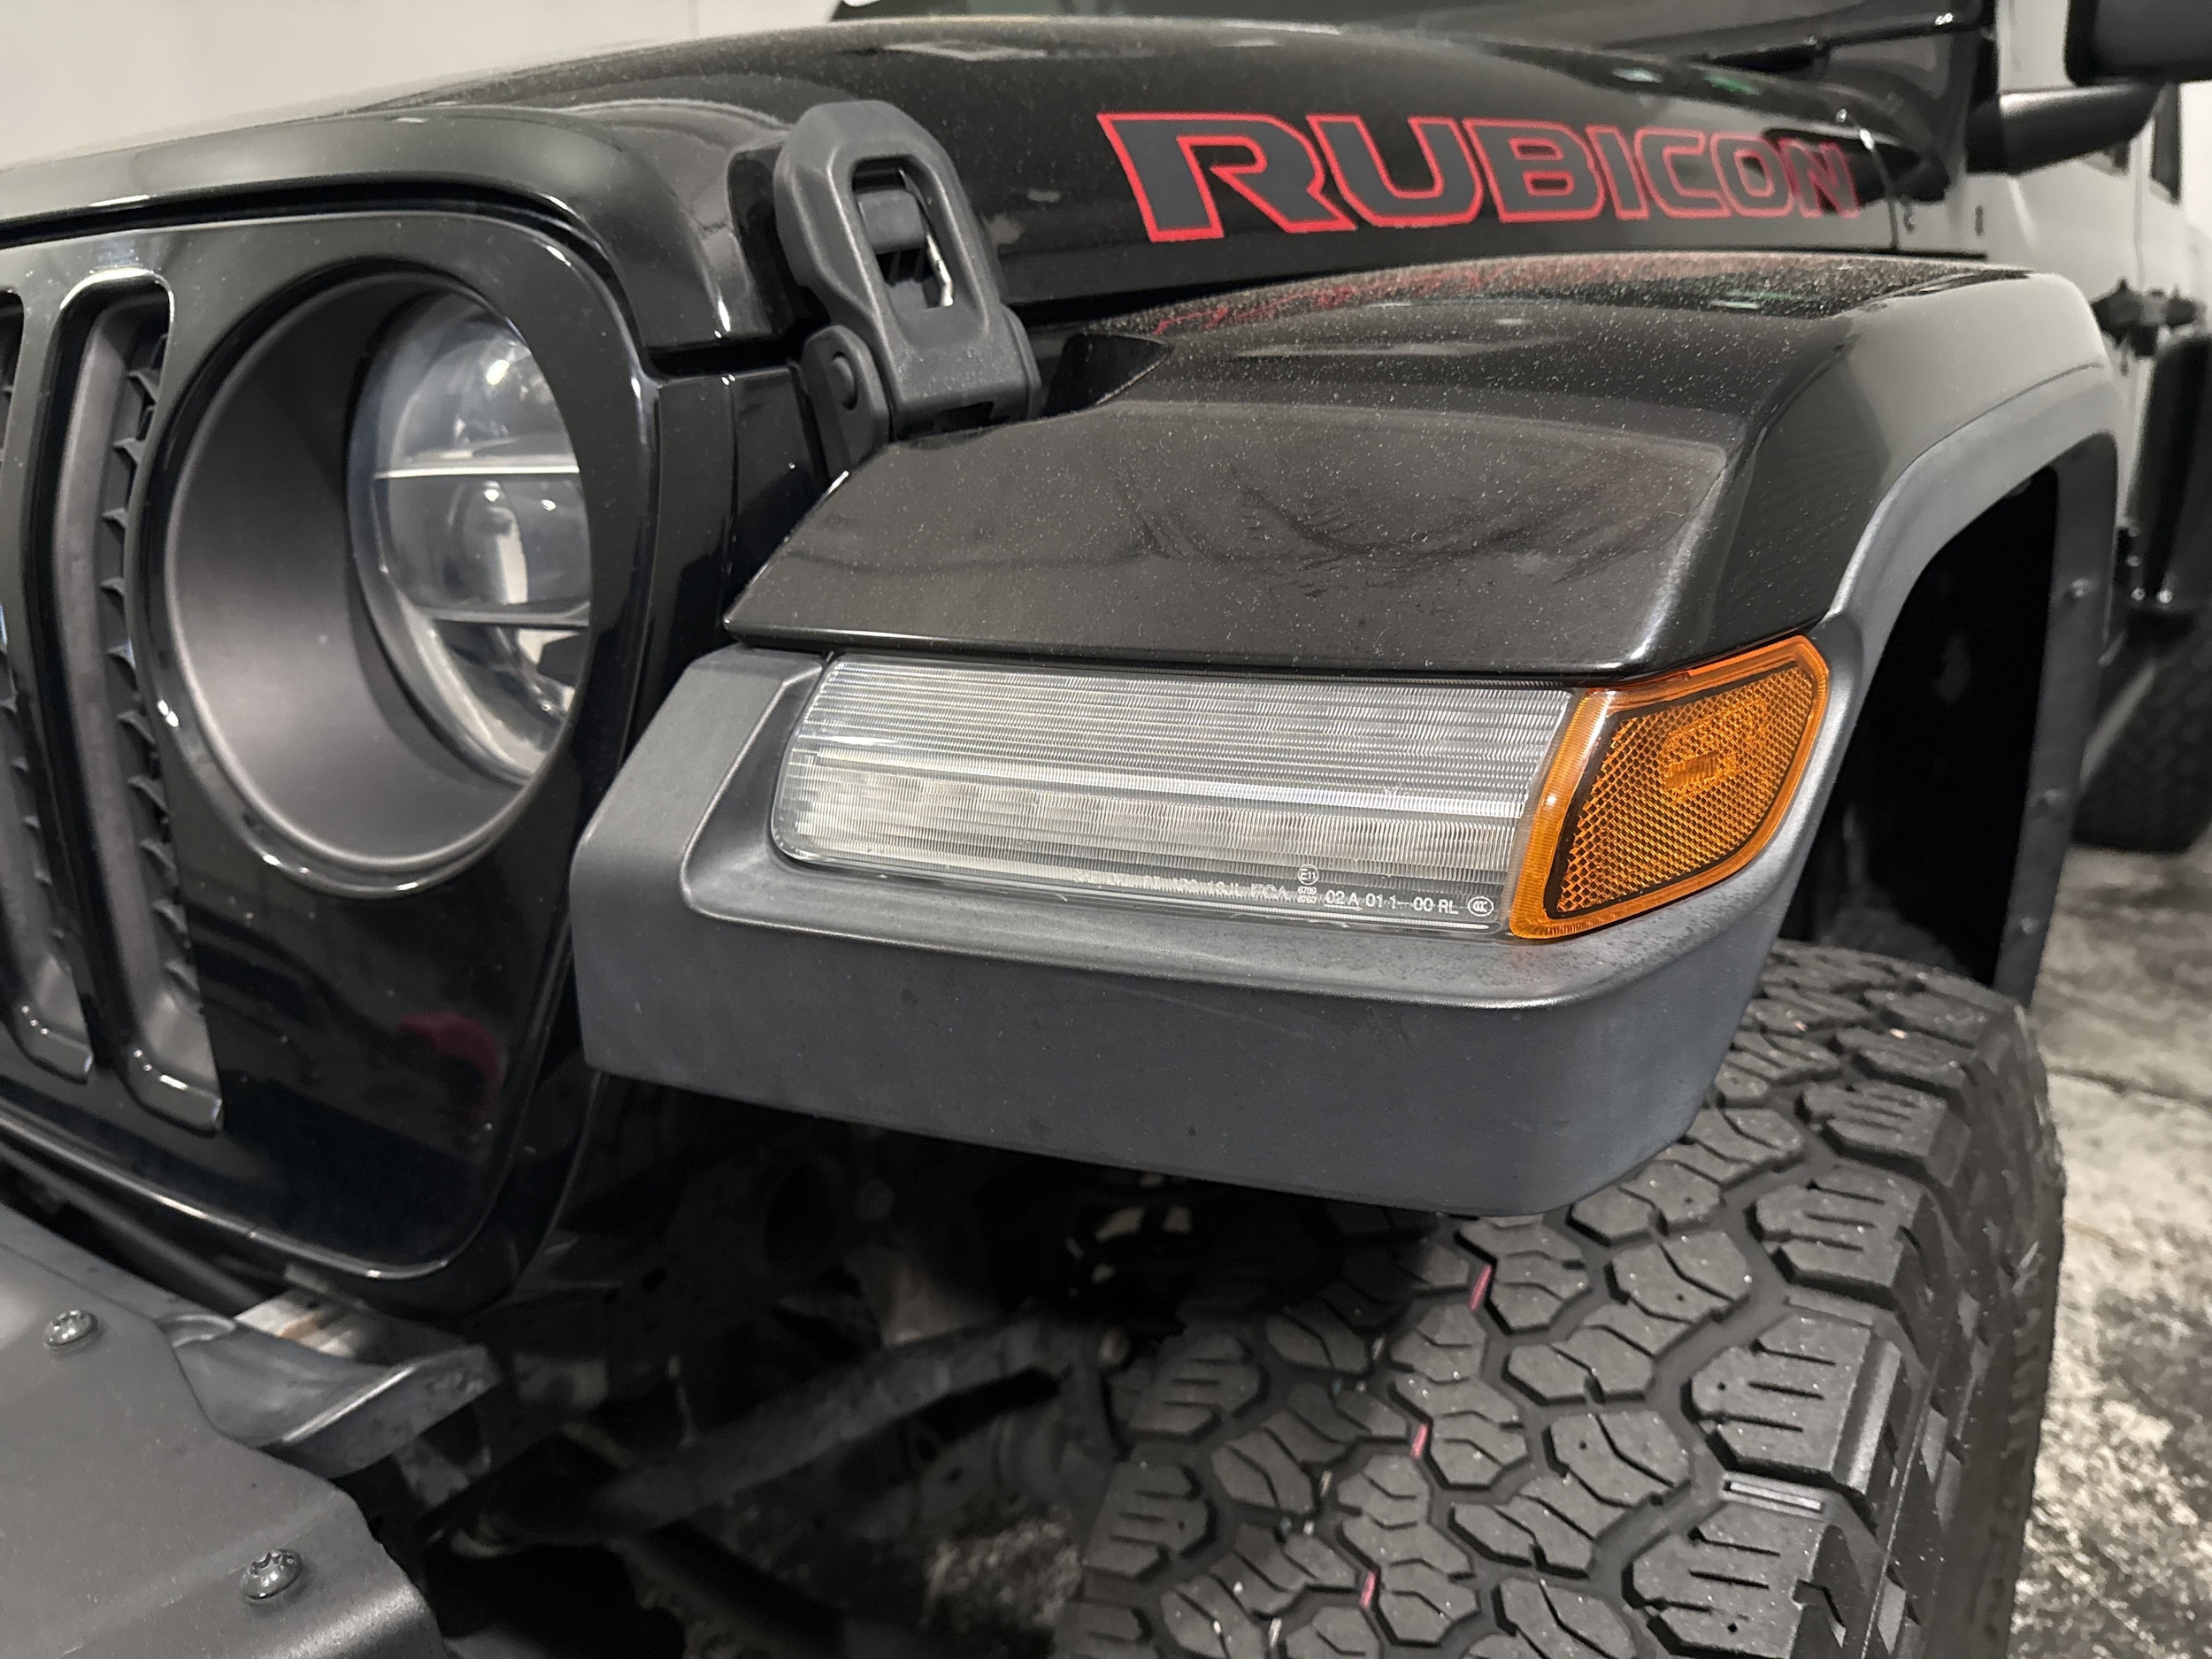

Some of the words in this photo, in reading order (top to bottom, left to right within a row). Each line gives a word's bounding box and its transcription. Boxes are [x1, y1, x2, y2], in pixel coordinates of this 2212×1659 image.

[1097, 112, 1861, 242] RUBICON
[1300, 868, 1317, 881] E11
[1438, 898, 1459, 915] RL
